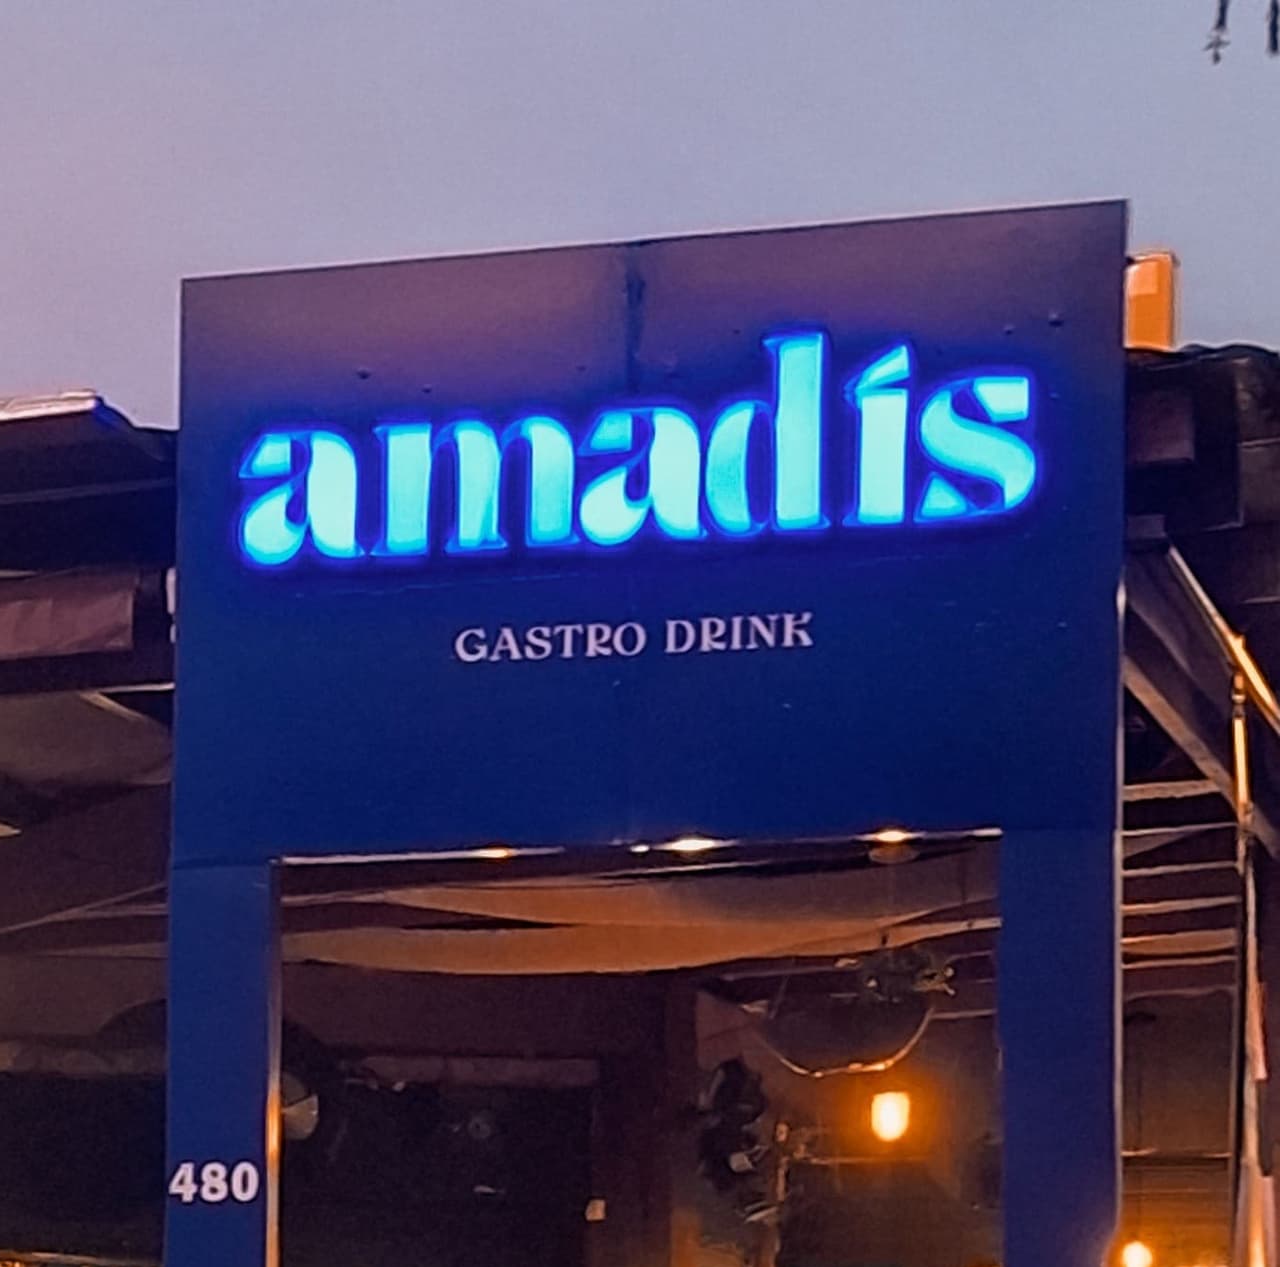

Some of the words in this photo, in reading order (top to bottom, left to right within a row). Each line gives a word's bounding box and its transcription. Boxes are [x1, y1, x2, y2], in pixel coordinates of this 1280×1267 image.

[454, 617, 647, 663] GASTRO
[665, 610, 814, 654] DRINK
[168, 1162, 259, 1202] 480
